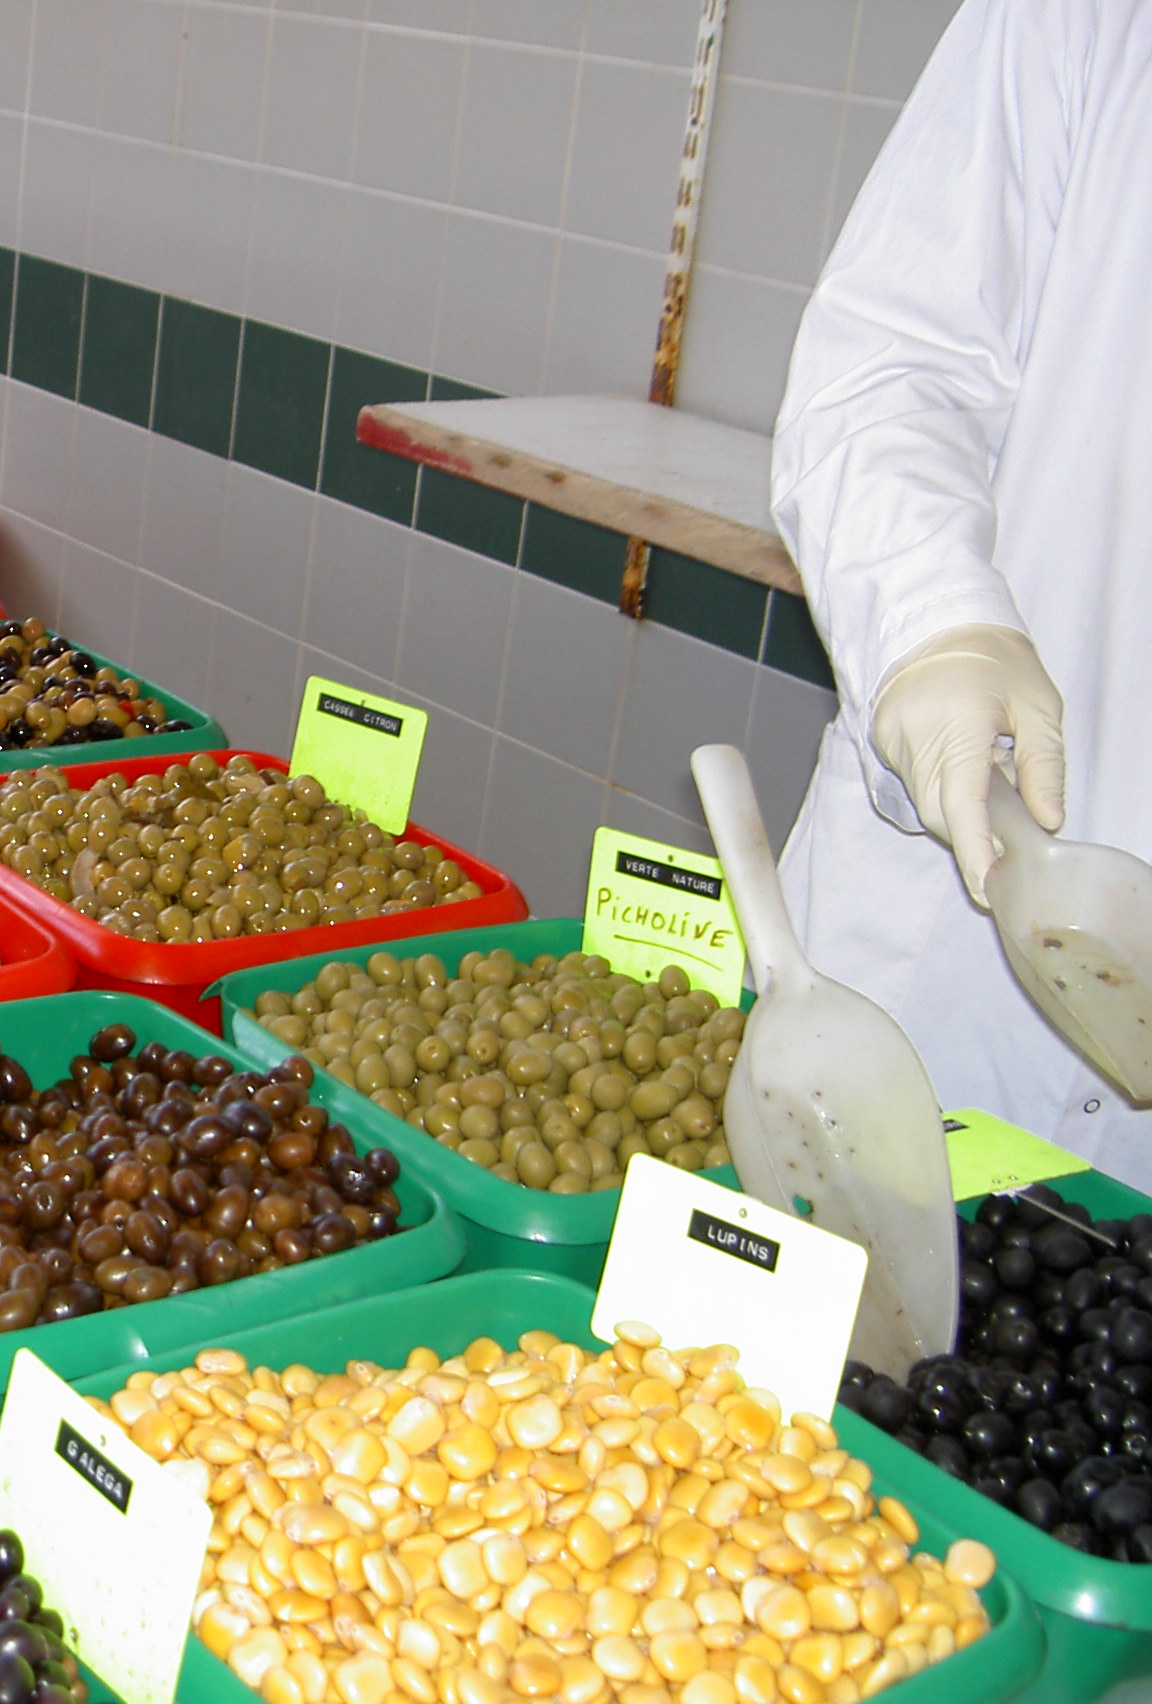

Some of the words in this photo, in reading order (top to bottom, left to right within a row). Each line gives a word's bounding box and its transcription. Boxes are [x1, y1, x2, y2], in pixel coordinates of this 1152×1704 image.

[363, 713, 398, 731] CITRON
[625, 860, 659, 878] VERTE
[671, 873, 714, 893] NATURE
[707, 1224, 769, 1260] LUPINS
[67, 1440, 123, 1499] GALEGA
